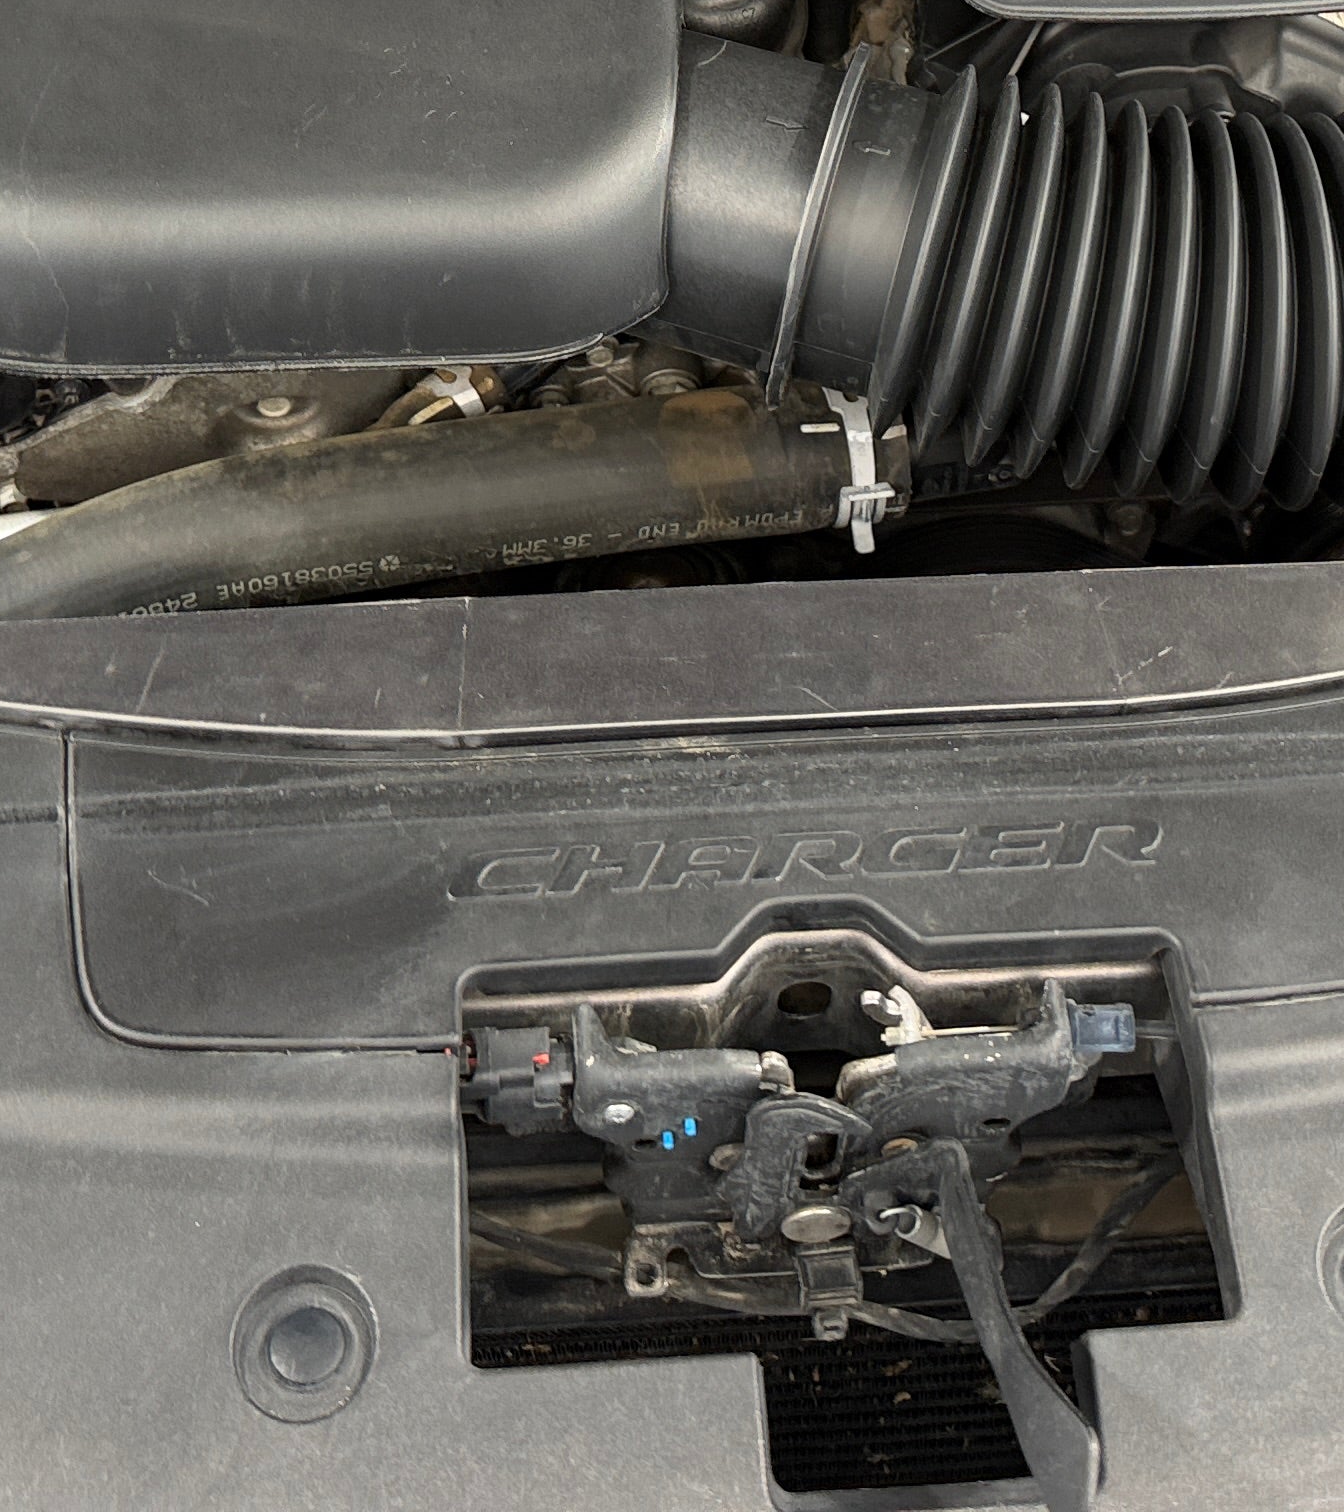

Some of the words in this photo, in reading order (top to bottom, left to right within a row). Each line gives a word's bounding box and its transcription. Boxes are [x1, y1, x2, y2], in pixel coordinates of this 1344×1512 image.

[502, 533, 593, 556] 36.3MM
[638, 522, 681, 539] END
[215, 560, 374, 602] 55038160AE
[448, 820, 1163, 901] CHARGER
